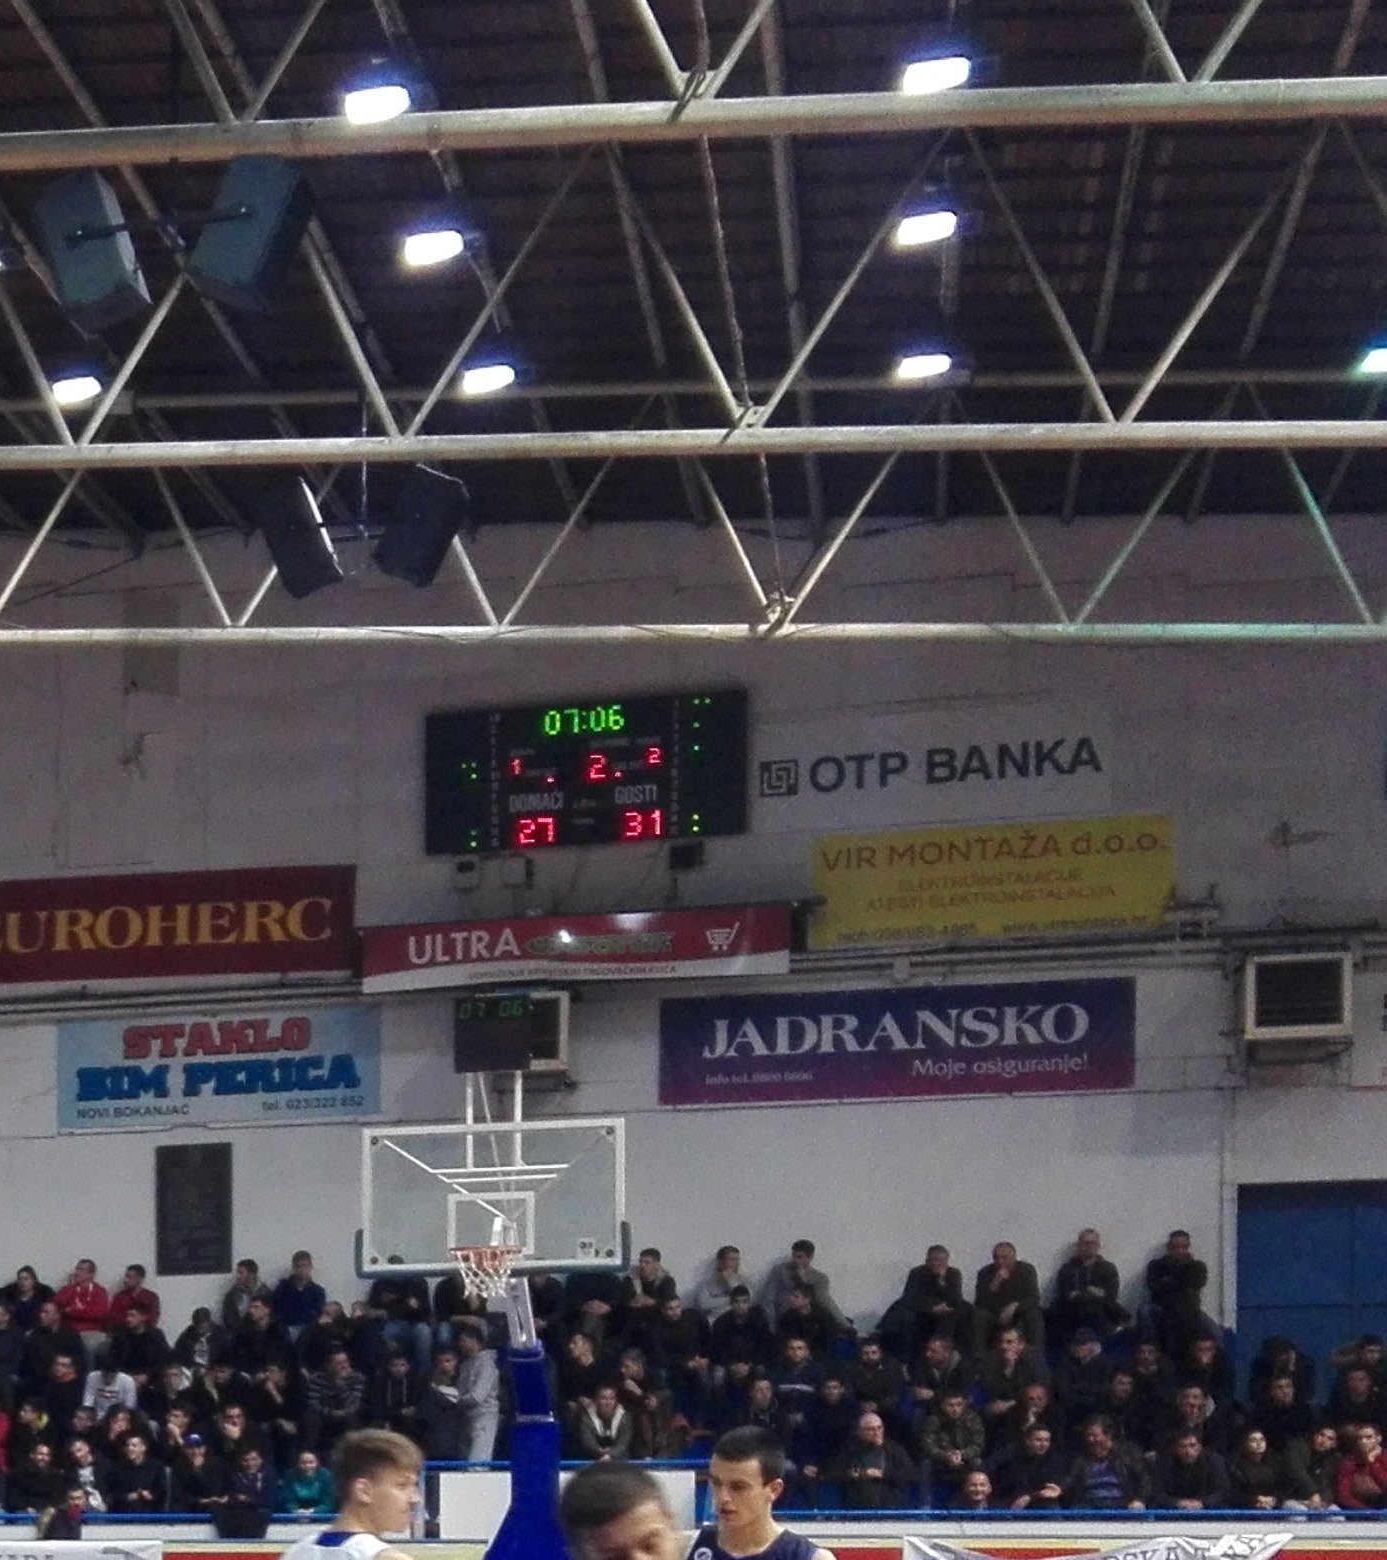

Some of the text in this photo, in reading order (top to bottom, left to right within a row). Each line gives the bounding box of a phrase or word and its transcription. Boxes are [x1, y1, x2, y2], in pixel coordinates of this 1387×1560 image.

[543, 704, 625, 736] 07:06
[808, 736, 1104, 794] OTP BANKA
[518, 816, 556, 844] 27
[625, 809, 662, 836] 31
[821, 845, 879, 872] VIR
[887, 830, 1063, 868] MONTAŽA
[408, 928, 521, 966] ULTRA
[123, 1016, 312, 1060] STAKLO
[702, 1002, 1091, 1060] JADRANSKO
[76, 1054, 362, 1102] BIM PERICA
[912, 1054, 1089, 1079] Moje osiguranje!
[76, 1103, 190, 1120] NOVI BOKANJAC
